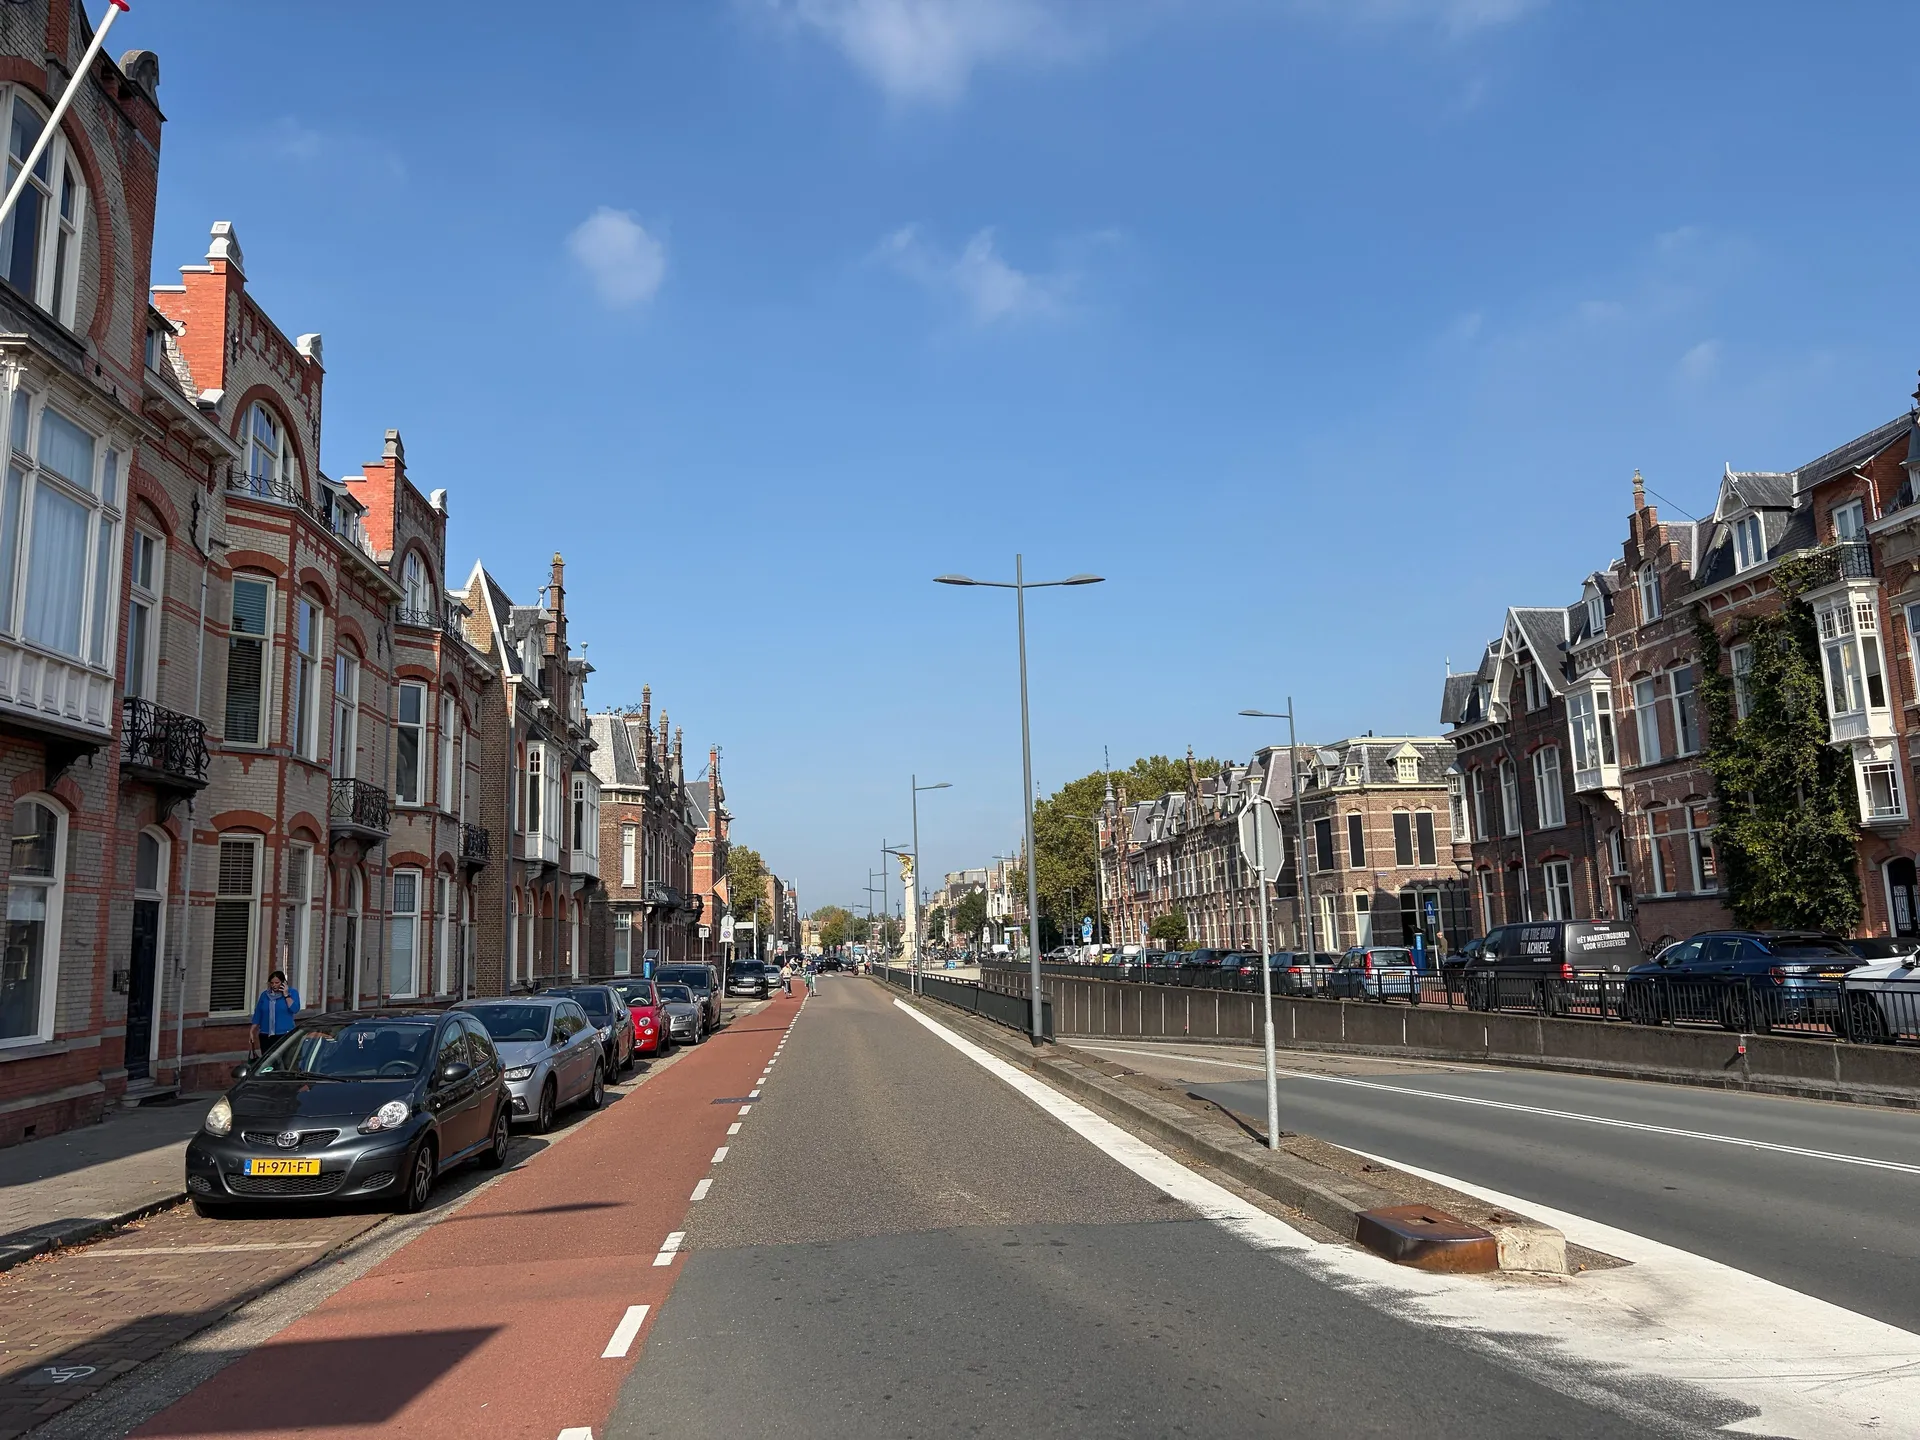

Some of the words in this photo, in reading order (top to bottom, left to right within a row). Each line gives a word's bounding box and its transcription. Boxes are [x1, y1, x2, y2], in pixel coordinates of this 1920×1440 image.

[1530, 928, 1540, 940] THE
[1540, 927, 1556, 939] ROAD
[1586, 931, 1630, 942] MARKETINGBUREAU
[1520, 942, 1527, 954] TO
[1526, 941, 1551, 954] ACHIEVE.
[1583, 942, 1596, 950] VOOR
[257, 1161, 312, 1173] H-971-FT
